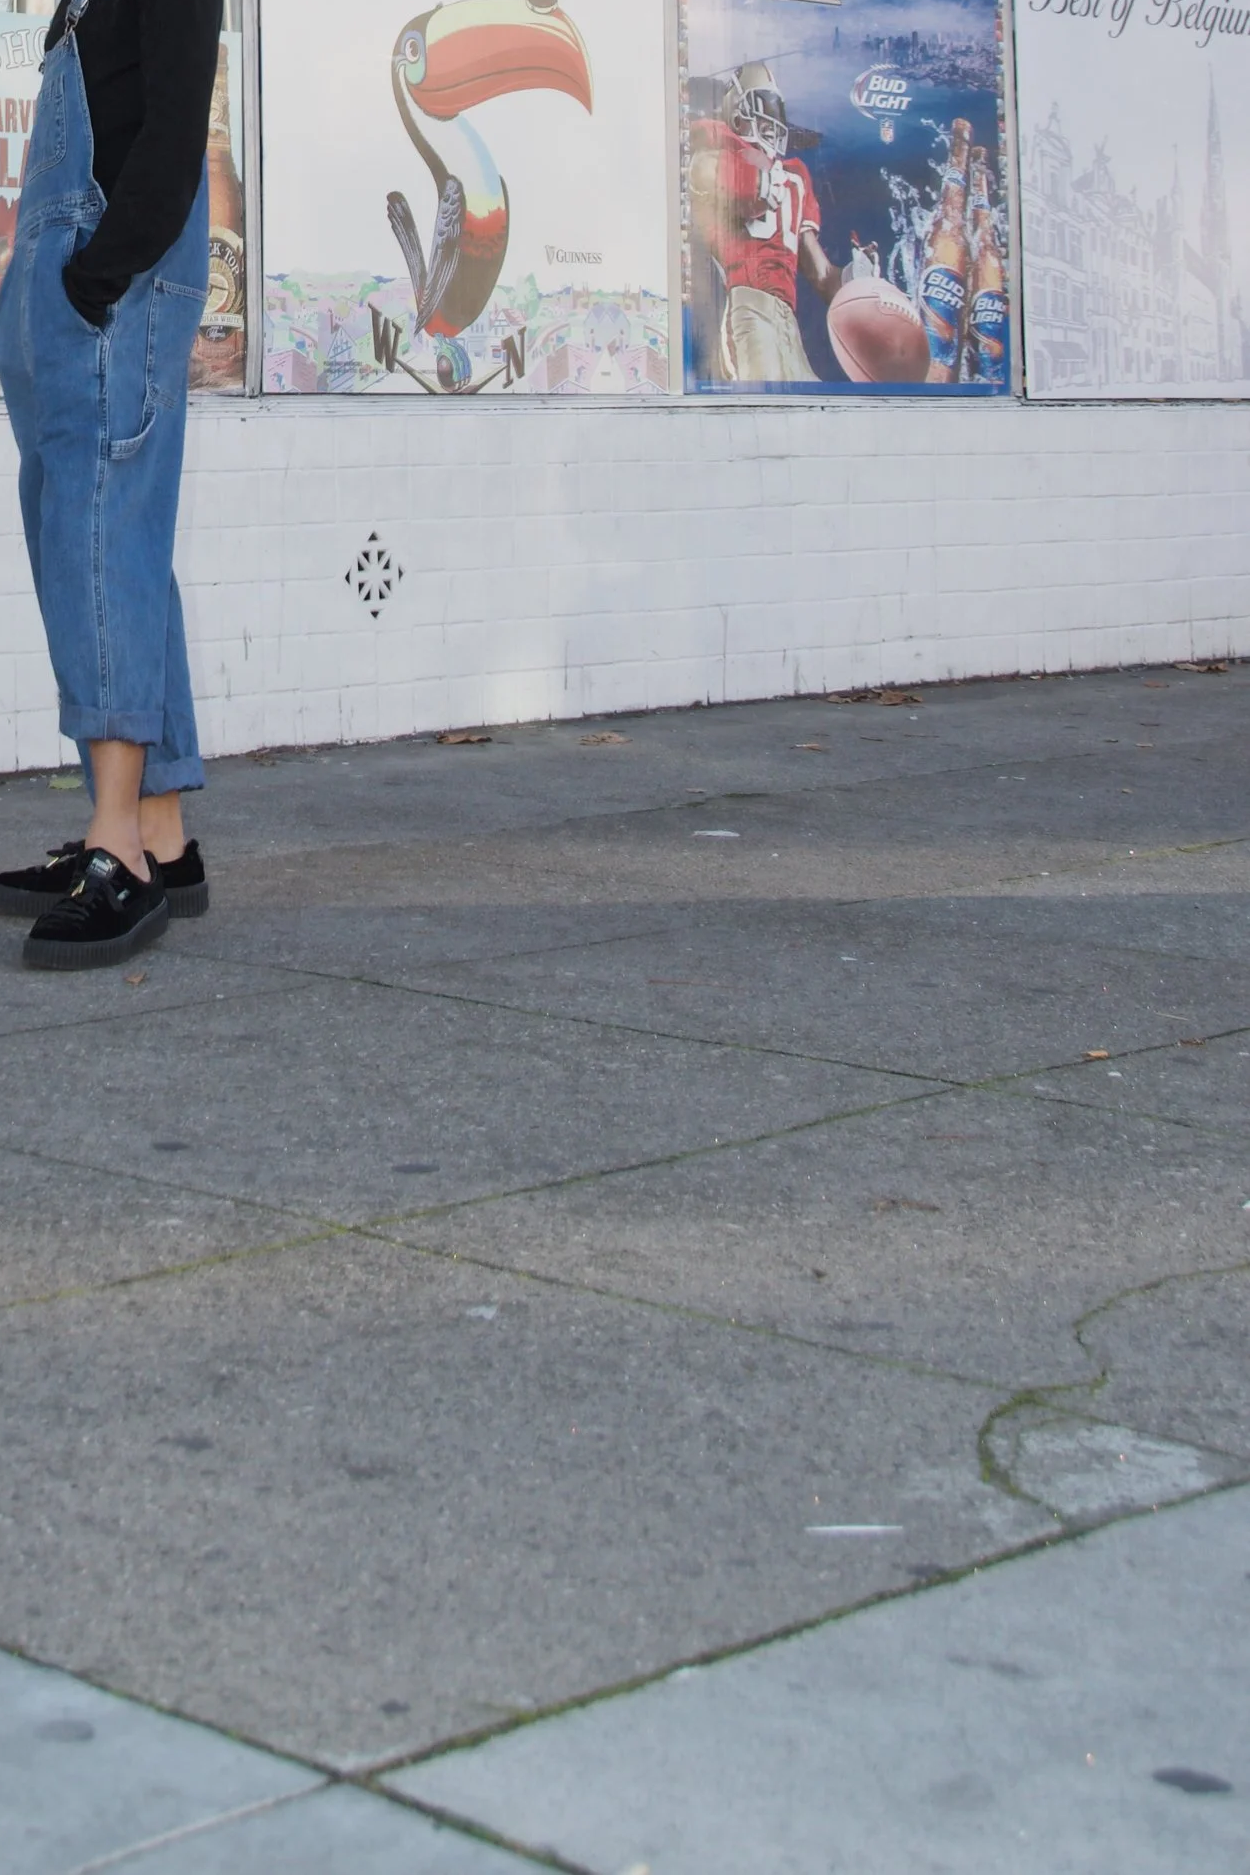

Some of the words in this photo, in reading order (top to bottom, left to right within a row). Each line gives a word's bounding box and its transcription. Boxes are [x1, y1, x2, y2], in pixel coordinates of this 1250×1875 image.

[869, 75, 907, 94] BUD
[860, 90, 913, 111] LIGHT
[224, 247, 239, 275] TOP
[556, 249, 602, 264] GUINNESS
[928, 271, 965, 297] BUD
[922, 284, 965, 309] LIGHT
